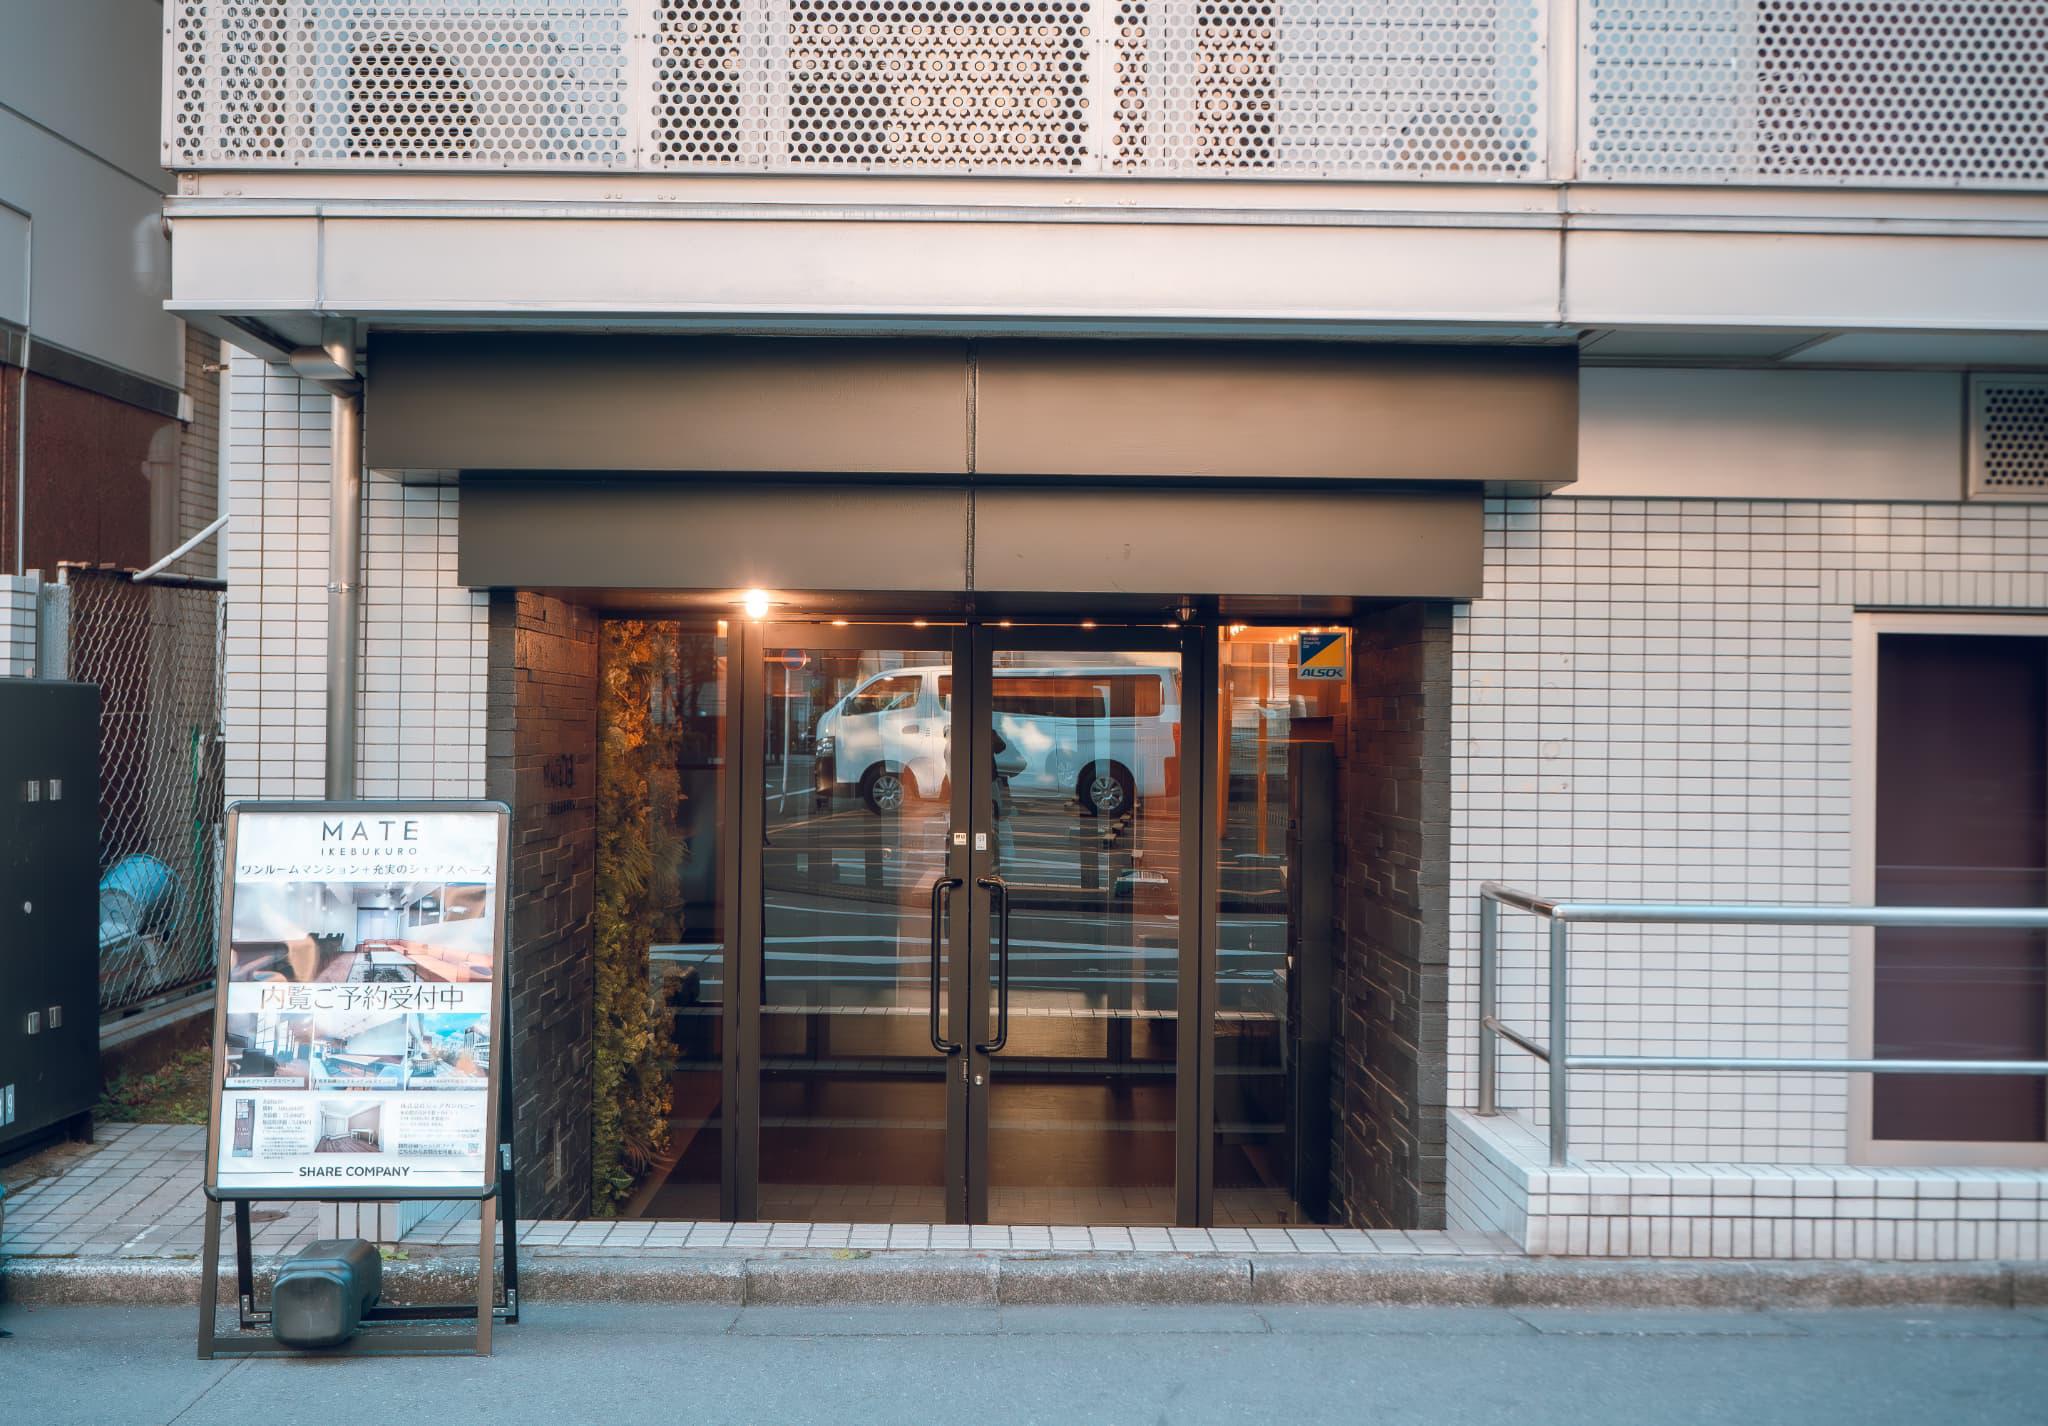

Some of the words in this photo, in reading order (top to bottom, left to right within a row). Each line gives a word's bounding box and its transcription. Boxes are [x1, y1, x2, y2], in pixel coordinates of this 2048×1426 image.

[1301, 668, 1343, 677] ALSOK
[322, 821, 418, 840] MATE
[321, 847, 417, 856] IKEBUKURO
[261, 985, 464, 1011] 内覧ご予約受付中
[299, 1166, 342, 1177] SHARE
[346, 1166, 410, 1177] COMPANY
